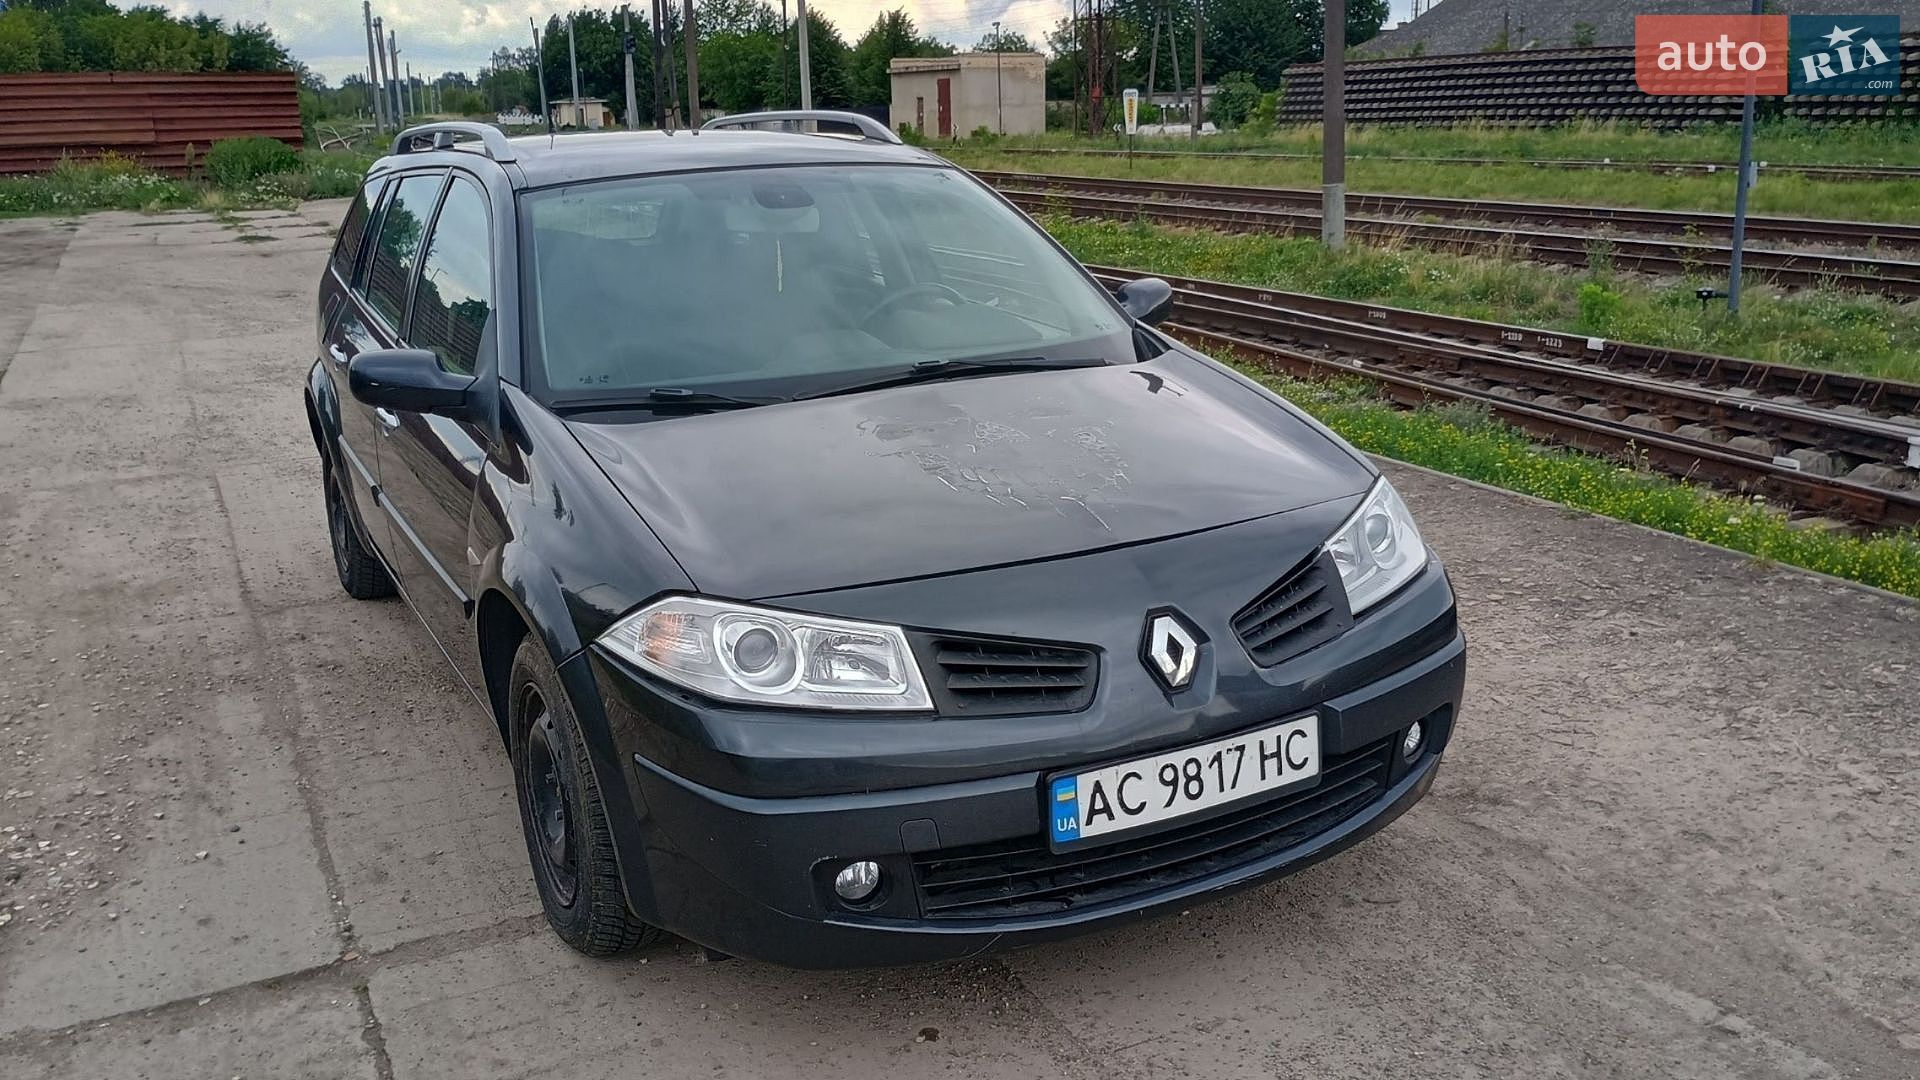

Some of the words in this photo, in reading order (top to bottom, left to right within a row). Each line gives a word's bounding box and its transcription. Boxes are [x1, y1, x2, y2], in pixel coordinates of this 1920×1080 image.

[1084, 771, 1147, 827] AC
[1158, 744, 1246, 810] 9817
[1258, 728, 1310, 781] HC
[1056, 817, 1078, 832] UA
